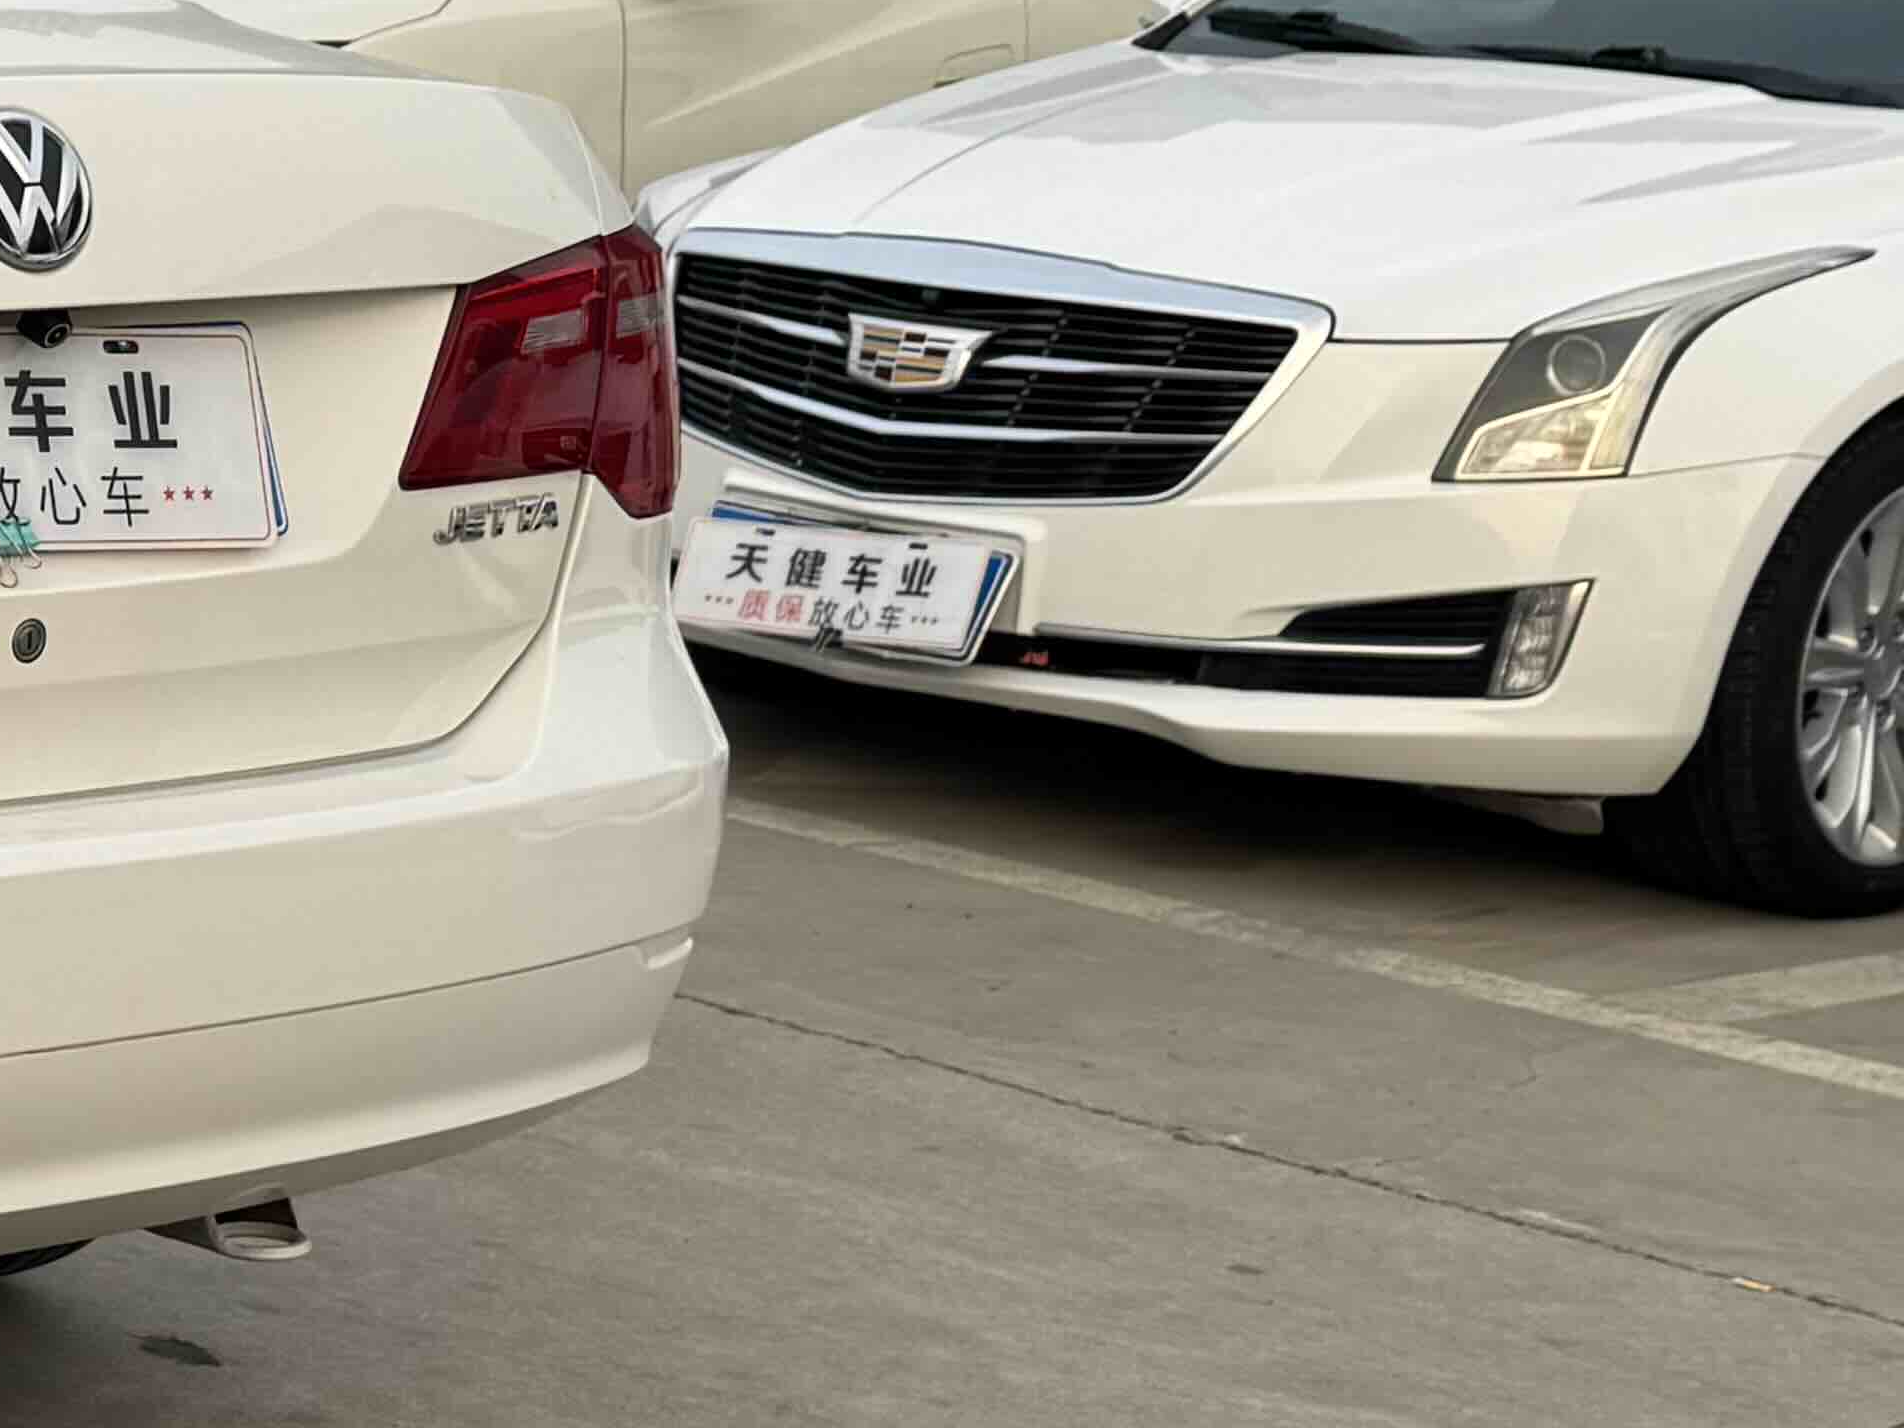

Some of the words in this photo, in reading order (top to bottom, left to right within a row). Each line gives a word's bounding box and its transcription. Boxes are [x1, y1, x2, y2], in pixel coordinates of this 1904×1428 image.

[432, 492, 560, 545] JETTA
[725, 540, 939, 600] 天健车业
[736, 587, 906, 634] 质保放心车
